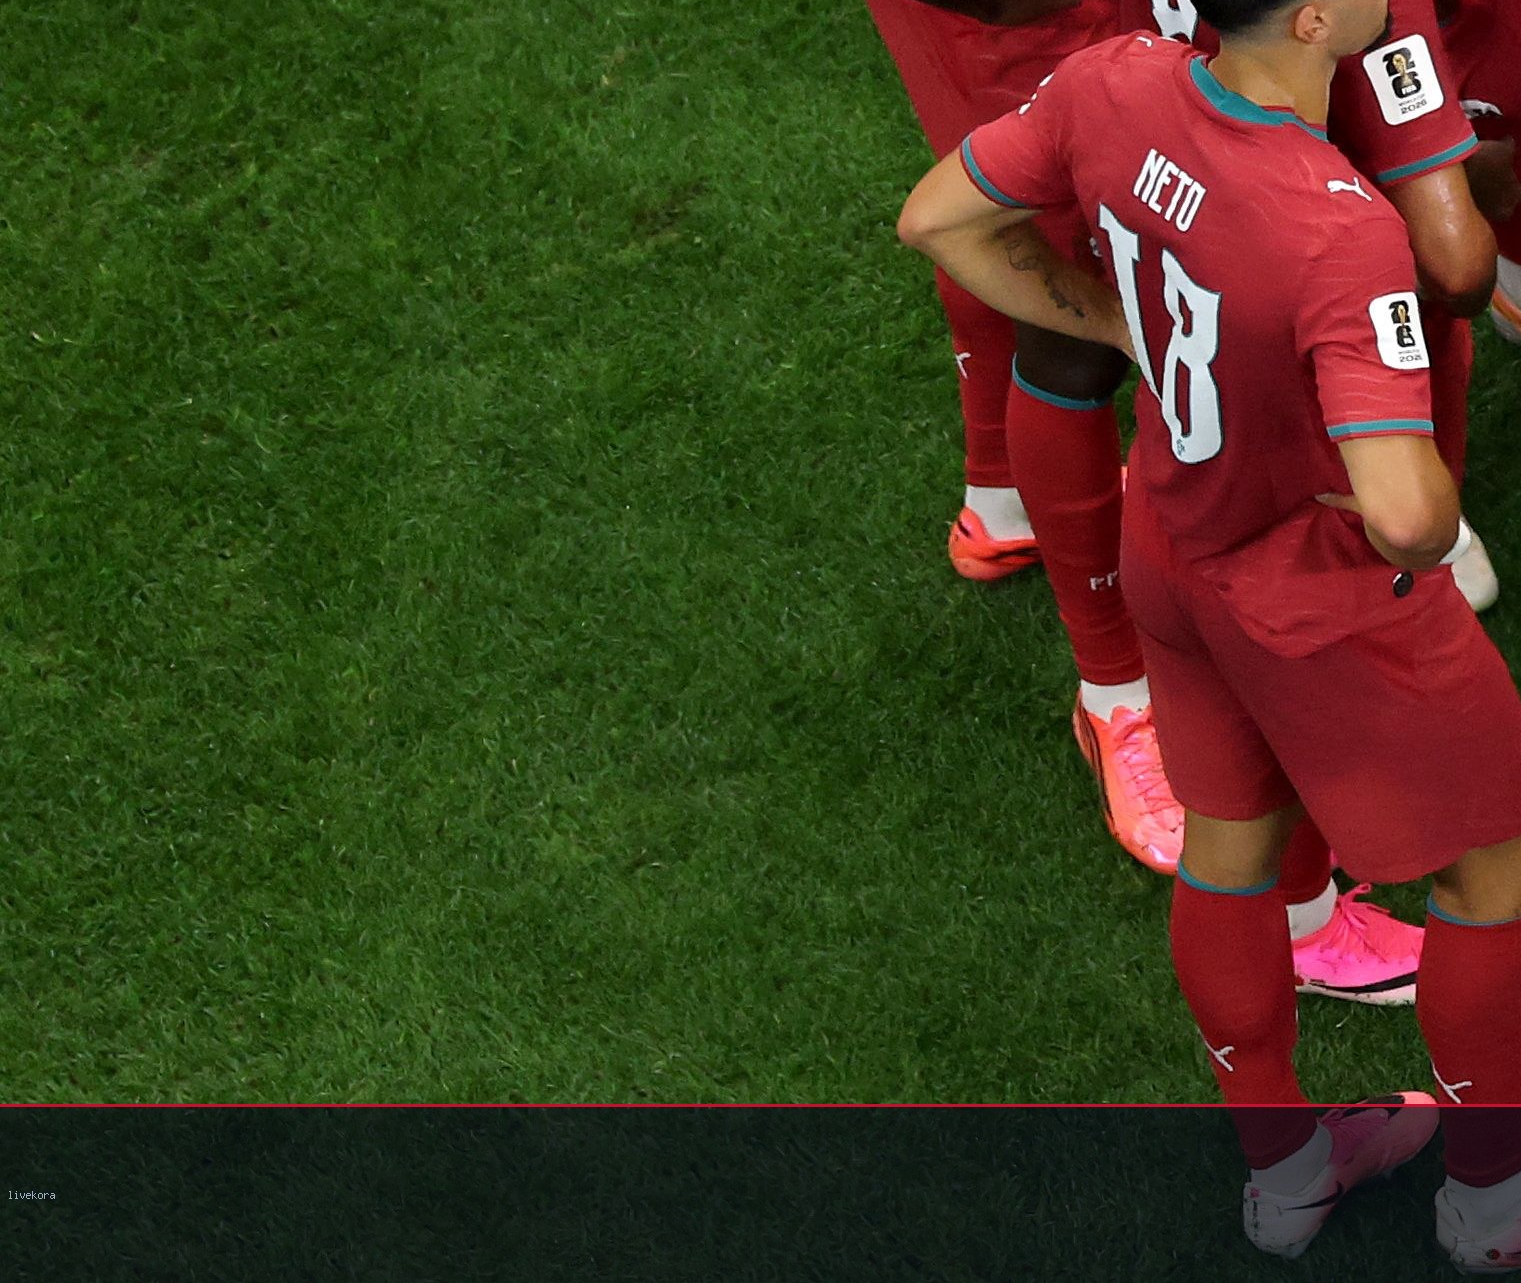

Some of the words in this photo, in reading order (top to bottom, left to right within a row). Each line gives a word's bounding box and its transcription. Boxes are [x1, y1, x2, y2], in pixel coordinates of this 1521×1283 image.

[1400, 97, 1428, 116] 2026
[1132, 147, 1207, 233] NETO
[1097, 201, 1224, 465] 18
